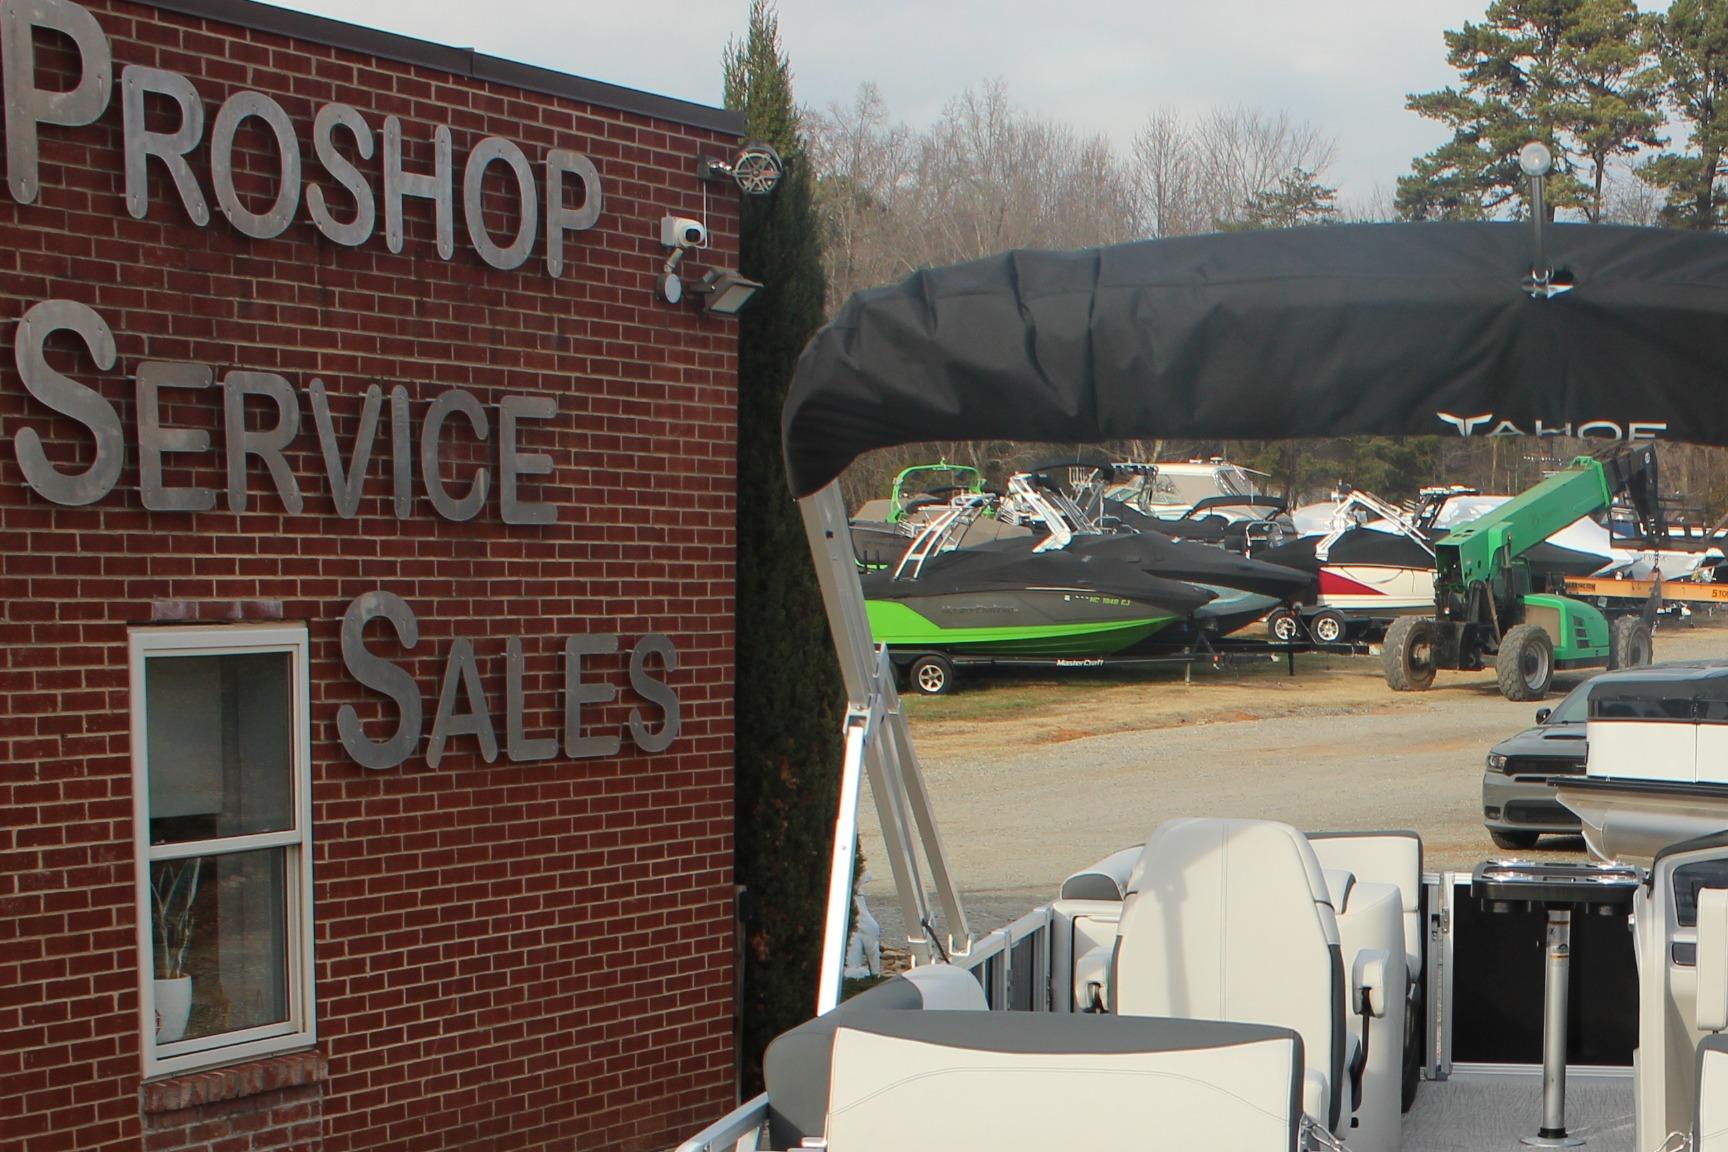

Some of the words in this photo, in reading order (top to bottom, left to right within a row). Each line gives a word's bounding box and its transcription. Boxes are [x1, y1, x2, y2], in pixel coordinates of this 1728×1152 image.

[4, 0, 603, 279] PROSHOP
[13, 298, 559, 526] SERVICE
[336, 590, 682, 771] SALES
[1056, 659, 1104, 667] MasterCraft
